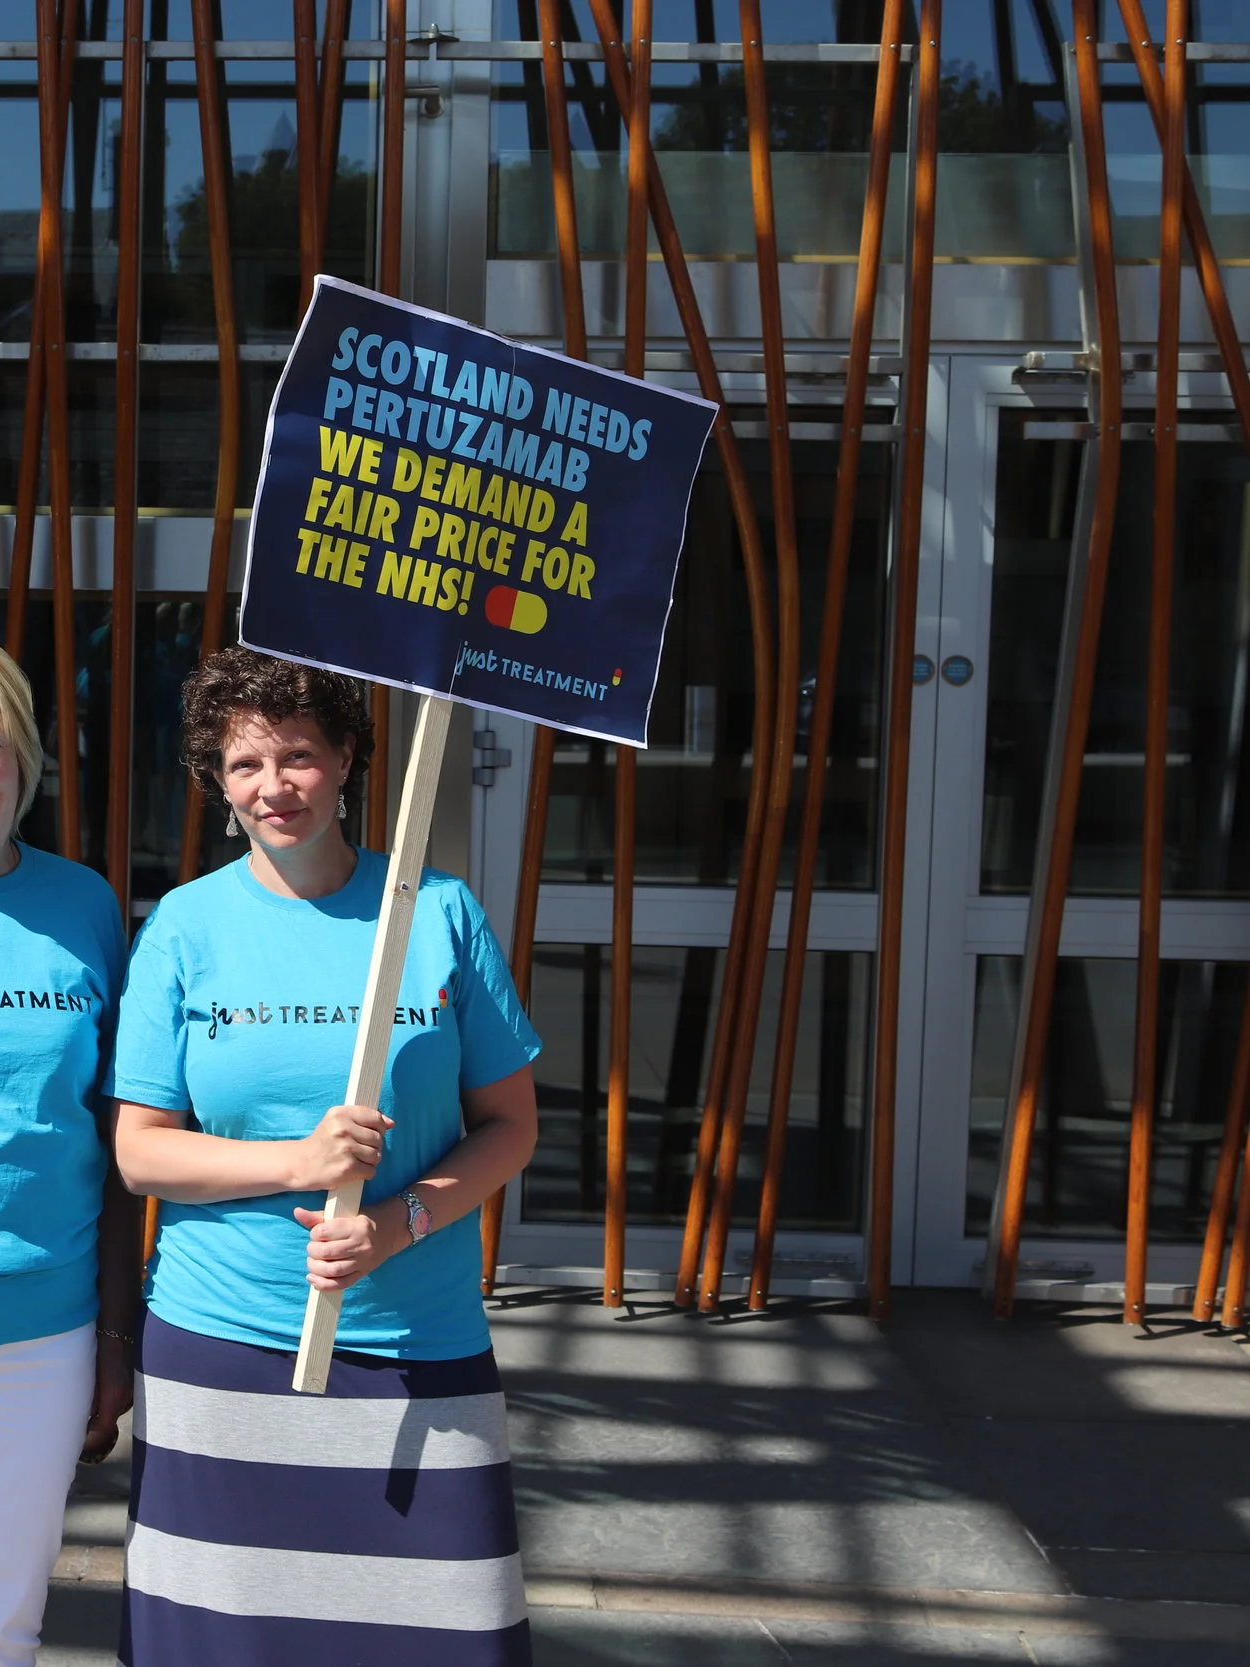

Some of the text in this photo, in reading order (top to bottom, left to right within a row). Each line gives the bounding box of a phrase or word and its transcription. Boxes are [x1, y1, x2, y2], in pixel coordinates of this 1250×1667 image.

[323, 377, 590, 493] PERTUZAMAB
[331, 326, 653, 461] SCOTLAND NEEDS
[304, 477, 597, 600] FAIR PRICE FOR
[318, 425, 589, 547] WE DEMAND A
[295, 528, 476, 616] THE NHS!
[456, 640, 609, 701] just TREATMENT
[208, 1001, 440, 1040] just TREATENT
